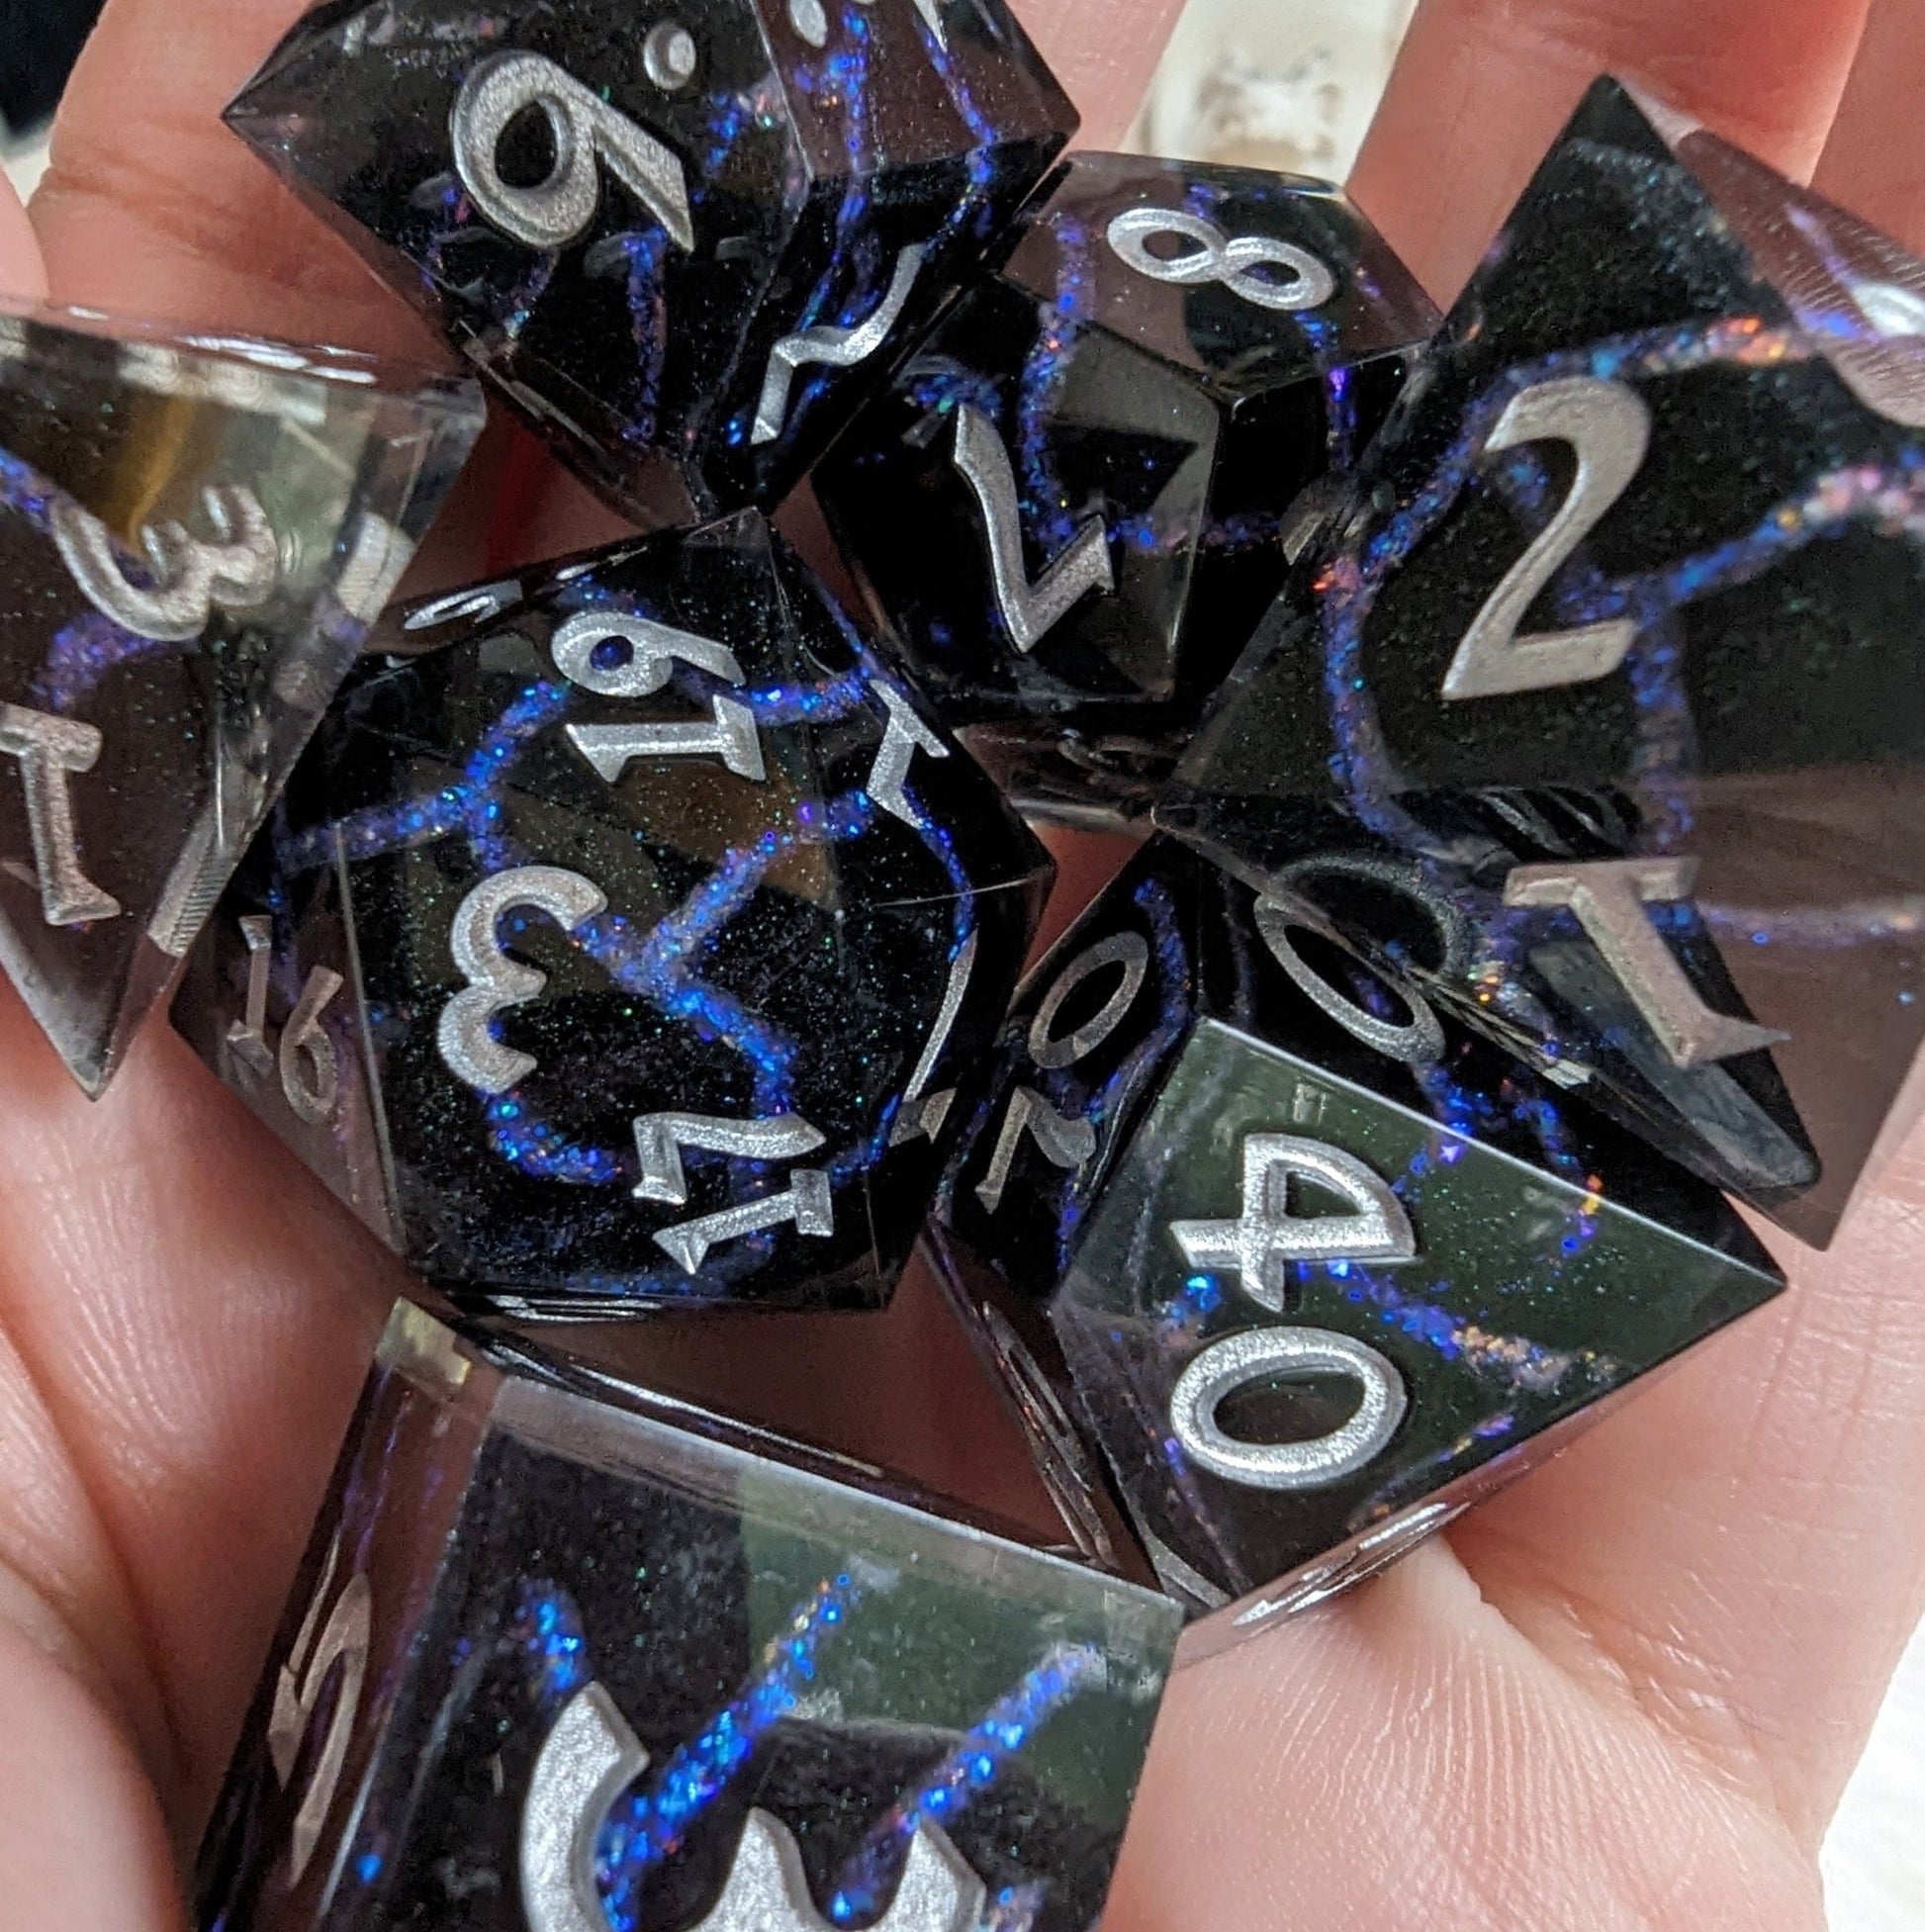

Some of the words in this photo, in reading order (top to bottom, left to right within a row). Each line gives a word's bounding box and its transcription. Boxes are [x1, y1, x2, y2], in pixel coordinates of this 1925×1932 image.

[1107, 206, 1334, 312] 8
[47, 480, 278, 642] 3
[954, 400, 1115, 654] 7
[1440, 377, 1652, 701] 2
[0, 700, 121, 927] 1
[227, 914, 344, 1126] 16
[437, 866, 608, 1093] 3
[1502, 857, 1790, 1069] 1
[1169, 1132, 1419, 1490] 40
